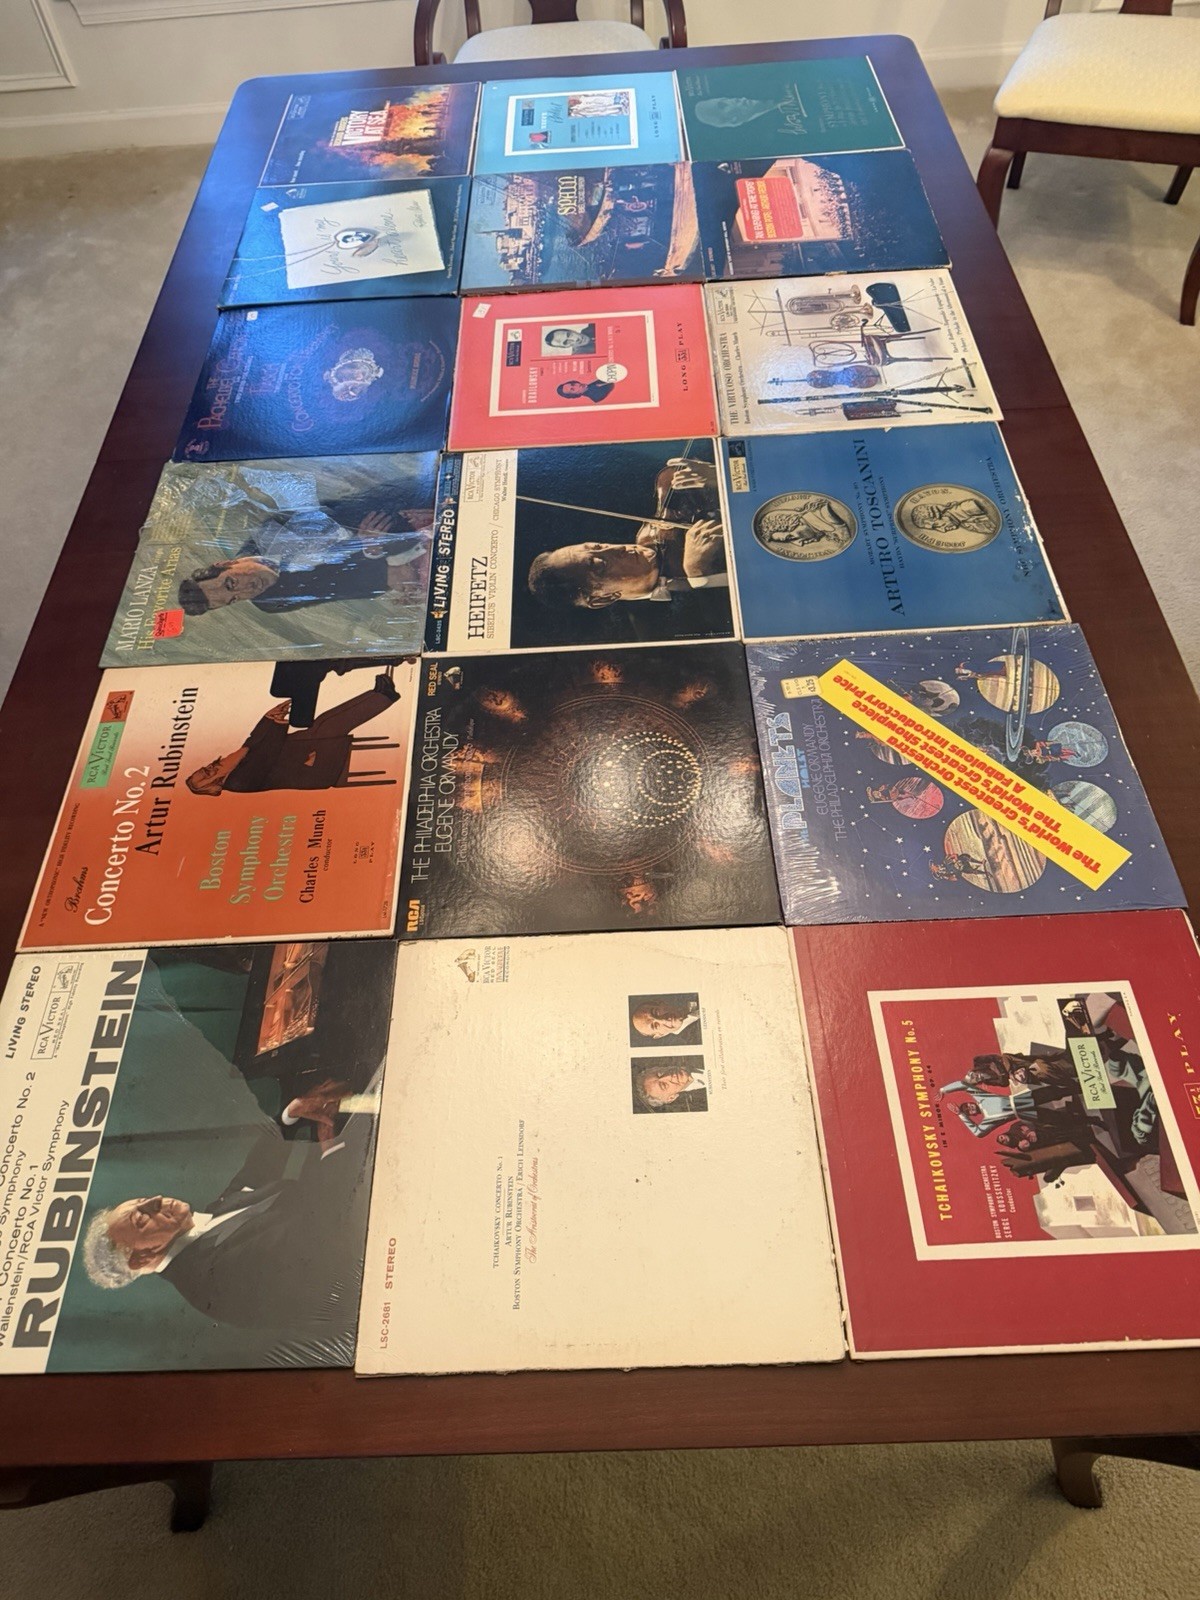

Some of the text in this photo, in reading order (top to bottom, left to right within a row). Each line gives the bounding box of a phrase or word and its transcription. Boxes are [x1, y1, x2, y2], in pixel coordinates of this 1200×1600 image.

[341, 110, 382, 146] VICTORY
[366, 109, 388, 125] SEA
[557, 175, 578, 215] SPAIN
[676, 321, 684, 346] PLAY
[606, 364, 617, 382] CHOPIN
[719, 331, 740, 425] THE VIRTUOSO ORCHESTRA
[438, 509, 455, 555] STEREO
[853, 437, 906, 616] ARTURO TOSCANINI
[879, 475, 905, 569] HAYDN SYMPHONY
[985, 456, 1024, 555] SYMPHONY ORCHESTRA
[154, 546, 182, 576] Arias
[489, 529, 499, 570] CONCERTO
[115, 565, 159, 652] MARIO LANZA
[433, 565, 450, 608] LIVING
[467, 556, 488, 640] HEIFETZ
[488, 572, 497, 600] VIOLIN
[487, 602, 495, 639] SIBELIUS
[427, 662, 439, 697] RED SEAL
[832, 675, 866, 702] Price
[865, 691, 950, 750] Introductory
[86, 725, 112, 784] RCA VICTOR
[134, 686, 198, 856] Artur Rubinstein
[765, 711, 808, 830] PLANETS
[798, 748, 811, 789] HOLST
[802, 722, 829, 815] EUGENE ORMANDY
[811, 698, 847, 842] THE PHILADELPHIA ORCHESTRA
[851, 699, 1062, 834] The World's Greatest Showpiece
[948, 743, 1014, 788] Fabulous
[410, 707, 442, 884] THE PHILADELPHIA ORCHESTRA
[434, 731, 460, 853] EUGENE ORMANDY
[886, 735, 1102, 874] The World's Greatest Orchestra
[1013, 782, 1027, 794] A
[84, 765, 150, 926] Concerto No. 2
[198, 830, 231, 890] Boston
[228, 815, 269, 905] Symphony
[262, 815, 297, 901] Orchestra
[298, 809, 326, 904] Charles Munch
[322, 838, 333, 871] conductor
[64, 866, 88, 913] Brahms
[406, 899, 421, 932] RCA
[5, 965, 42, 1060] LIVING STEREO
[37, 996, 61, 1055] RCA VICTOR
[906, 1027, 916, 1044] No.
[1077, 1043, 1101, 1102] RCA VICTOR
[1167, 1012, 1195, 1074] PLAY
[907, 1049, 933, 1118] SYMPHONY
[0, 1071, 36, 1187] Concerto No. 2
[12, 959, 143, 1349] RUBINSTEIN
[29, 1175, 48, 1216] Victor
[42, 1099, 69, 1171] Symphony
[516, 1118, 525, 1157] LEINSDORF
[0, 1149, 26, 1225] Symphony
[505, 1175, 514, 1219] RUBINSTEIN
[922, 1124, 953, 1221] TCHAIKOVSKY
[979, 1165, 1002, 1239] BOSTON SYMPHONY ORCHESTRA
[989, 1164, 1013, 1239] SERGE KOUSSEVITZKY
[1005, 1187, 1016, 1213] Conductor
[0, 1206, 27, 1286] Concerto
[20, 1173, 37, 1200] No.
[514, 1187, 523, 1232] ORCHESTRA
[492, 1216, 501, 1269] TCHAIKOVSKY
[513, 1234, 522, 1276] SYMPHONY
[524, 1245, 538, 1264] The
[379, 1236, 397, 1350] LSC-2681 STEREO
[512, 1279, 521, 1310] BOSTON
